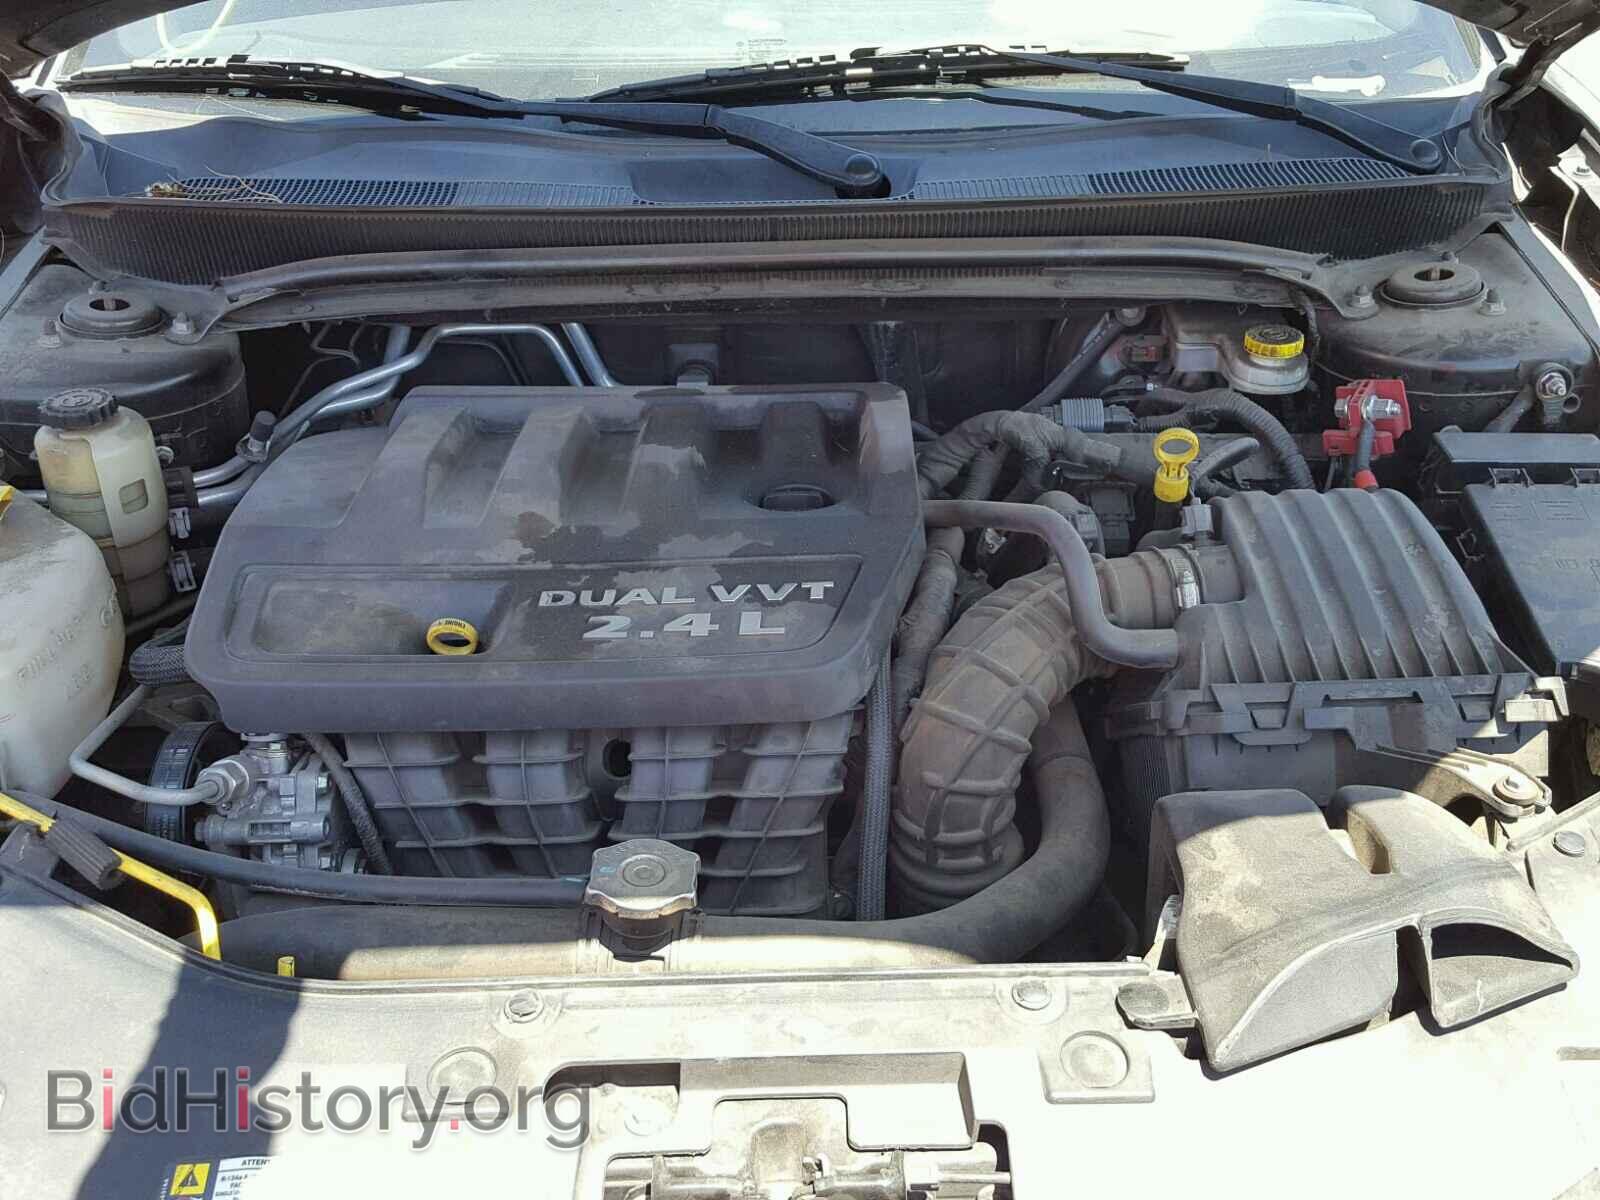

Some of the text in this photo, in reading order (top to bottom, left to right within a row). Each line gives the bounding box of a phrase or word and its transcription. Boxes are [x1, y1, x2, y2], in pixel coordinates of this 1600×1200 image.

[537, 581, 835, 607] DUAL VVT
[582, 611, 786, 639] 2.4 L
[241, 1159, 271, 1167] ATTEN
